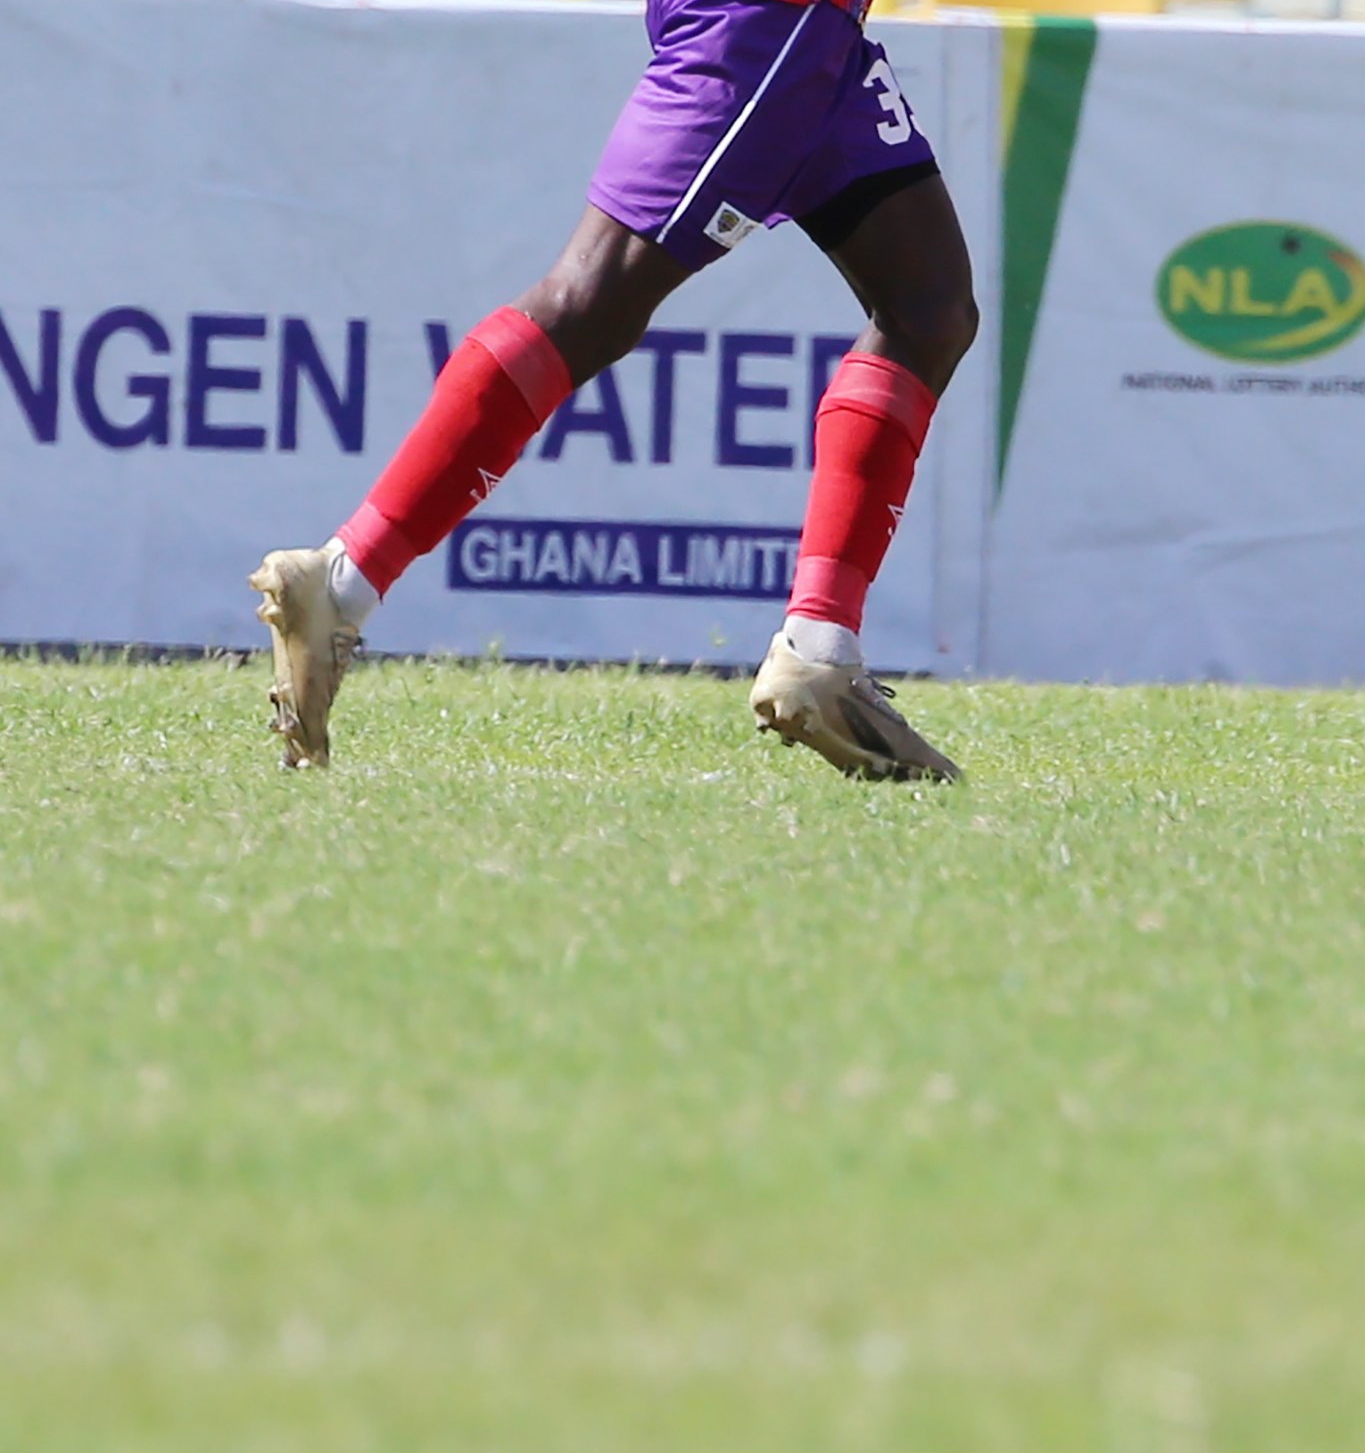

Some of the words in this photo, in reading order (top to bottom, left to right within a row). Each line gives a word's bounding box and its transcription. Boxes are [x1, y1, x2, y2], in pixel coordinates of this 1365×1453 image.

[1168, 264, 1339, 317] NLA
[424, 321, 859, 471] ATE
[460, 525, 642, 585] GHANA
